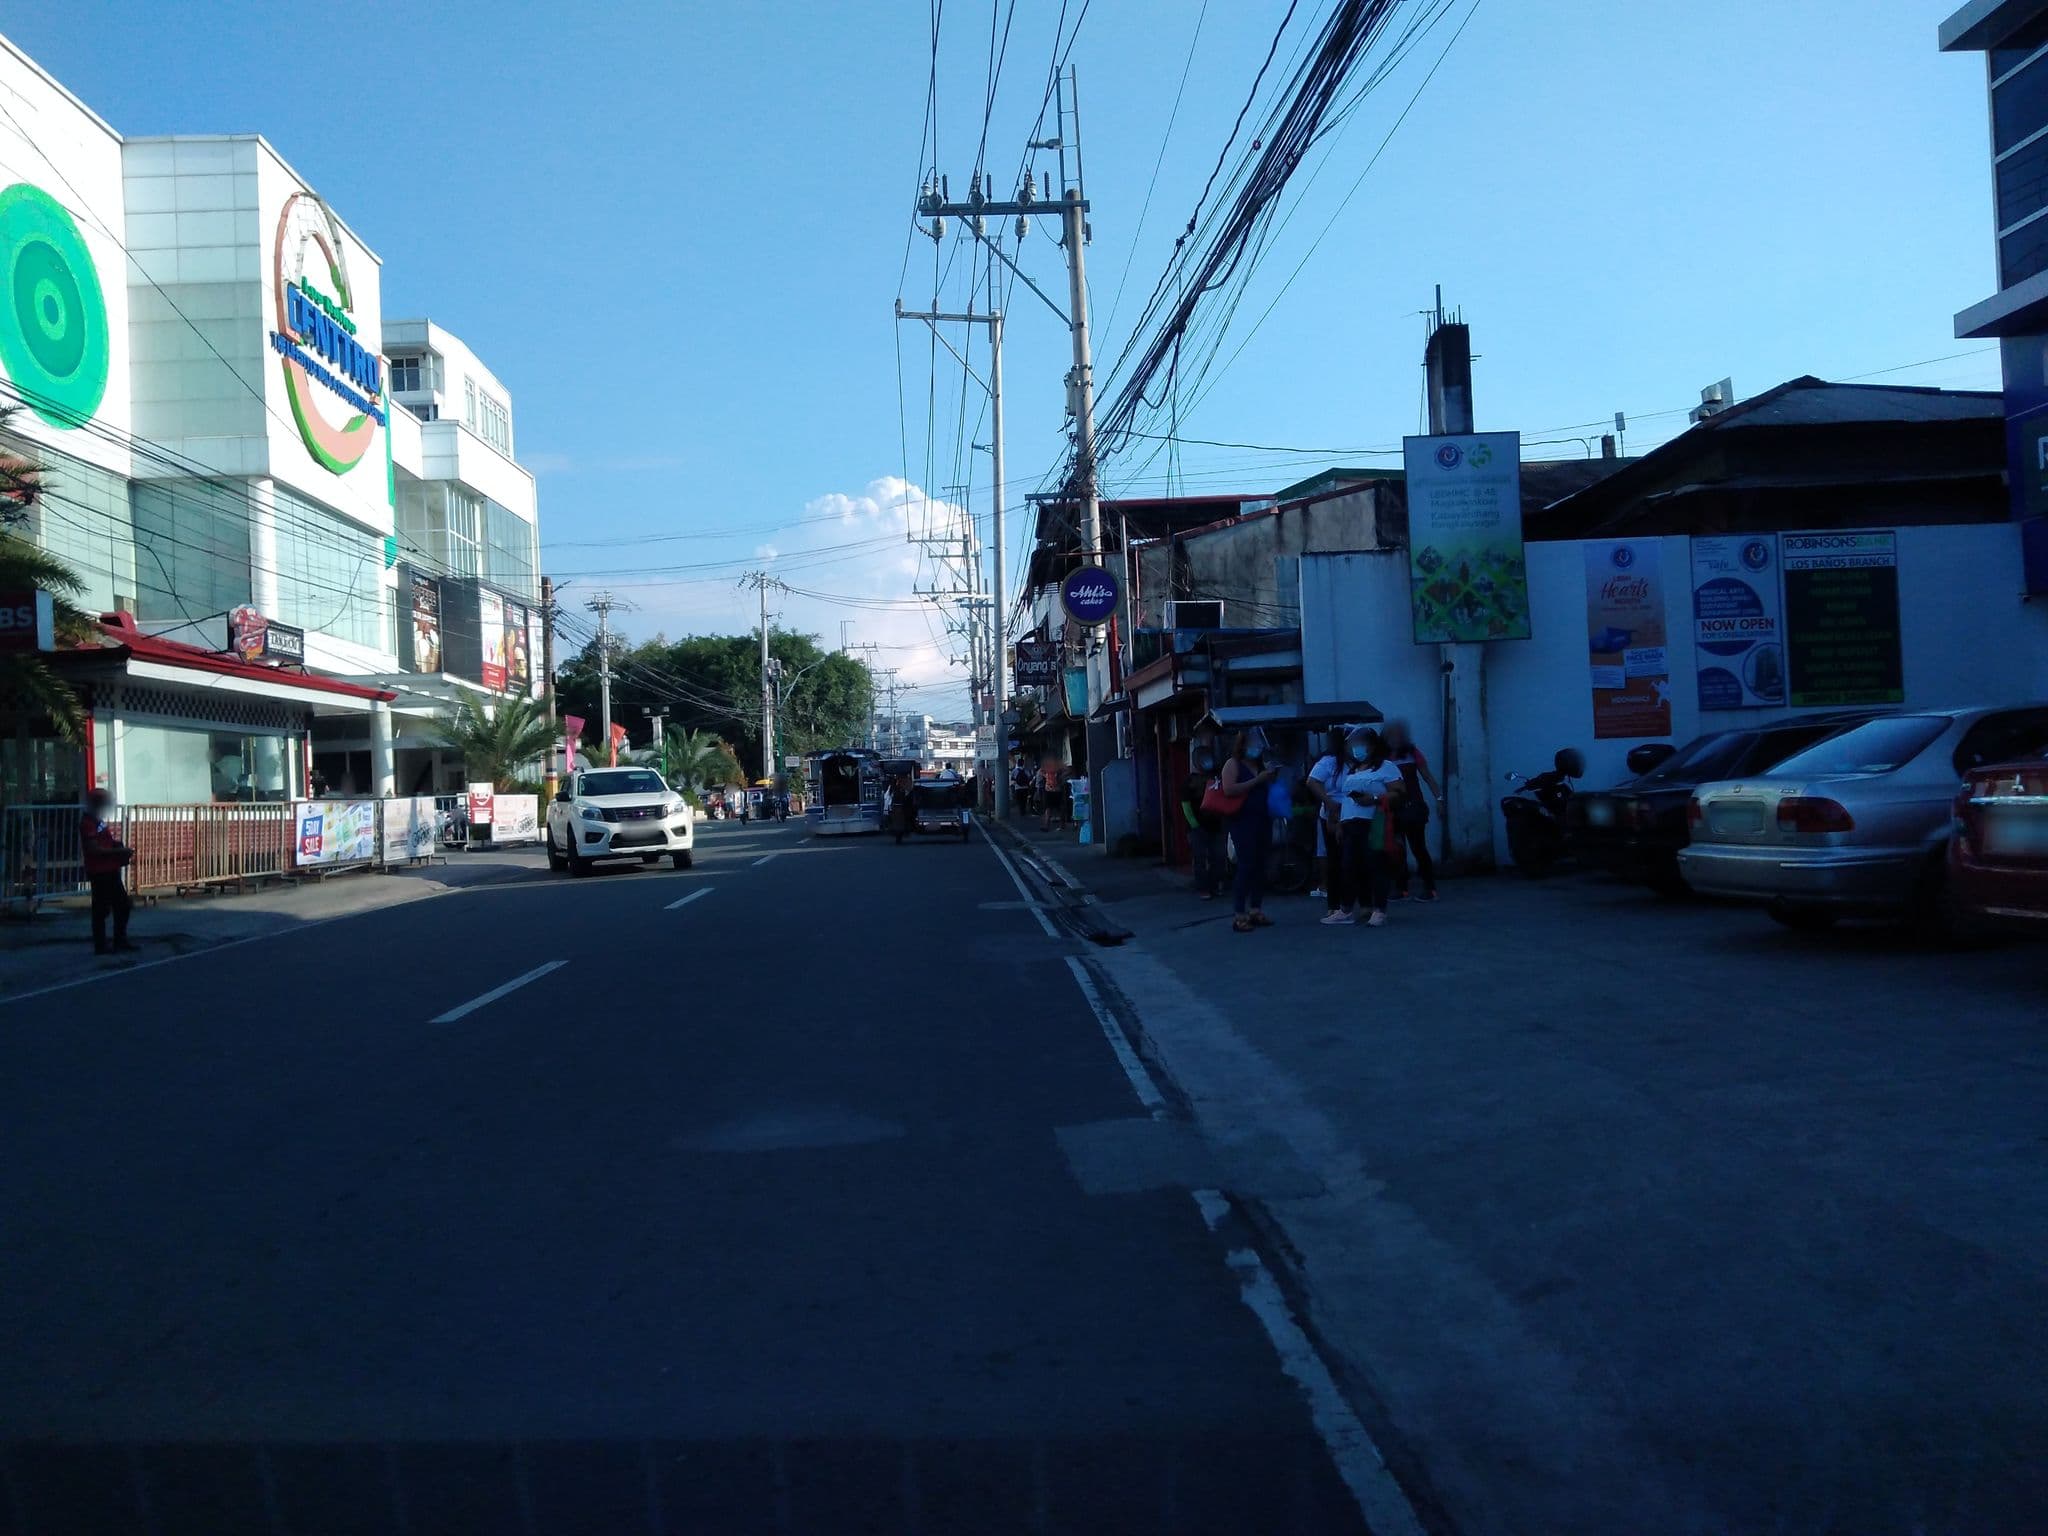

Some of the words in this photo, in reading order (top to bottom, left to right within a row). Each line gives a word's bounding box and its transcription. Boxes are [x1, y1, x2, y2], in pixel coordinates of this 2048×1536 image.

[1786, 536, 1857, 550] ROBINSONS
[1791, 560, 1810, 570] LOS
[1849, 556, 1891, 568] BRANCH
[1701, 619, 1736, 632] NOW
[1740, 617, 1775, 631] OPEN
[304, 836, 321, 854] SALE
